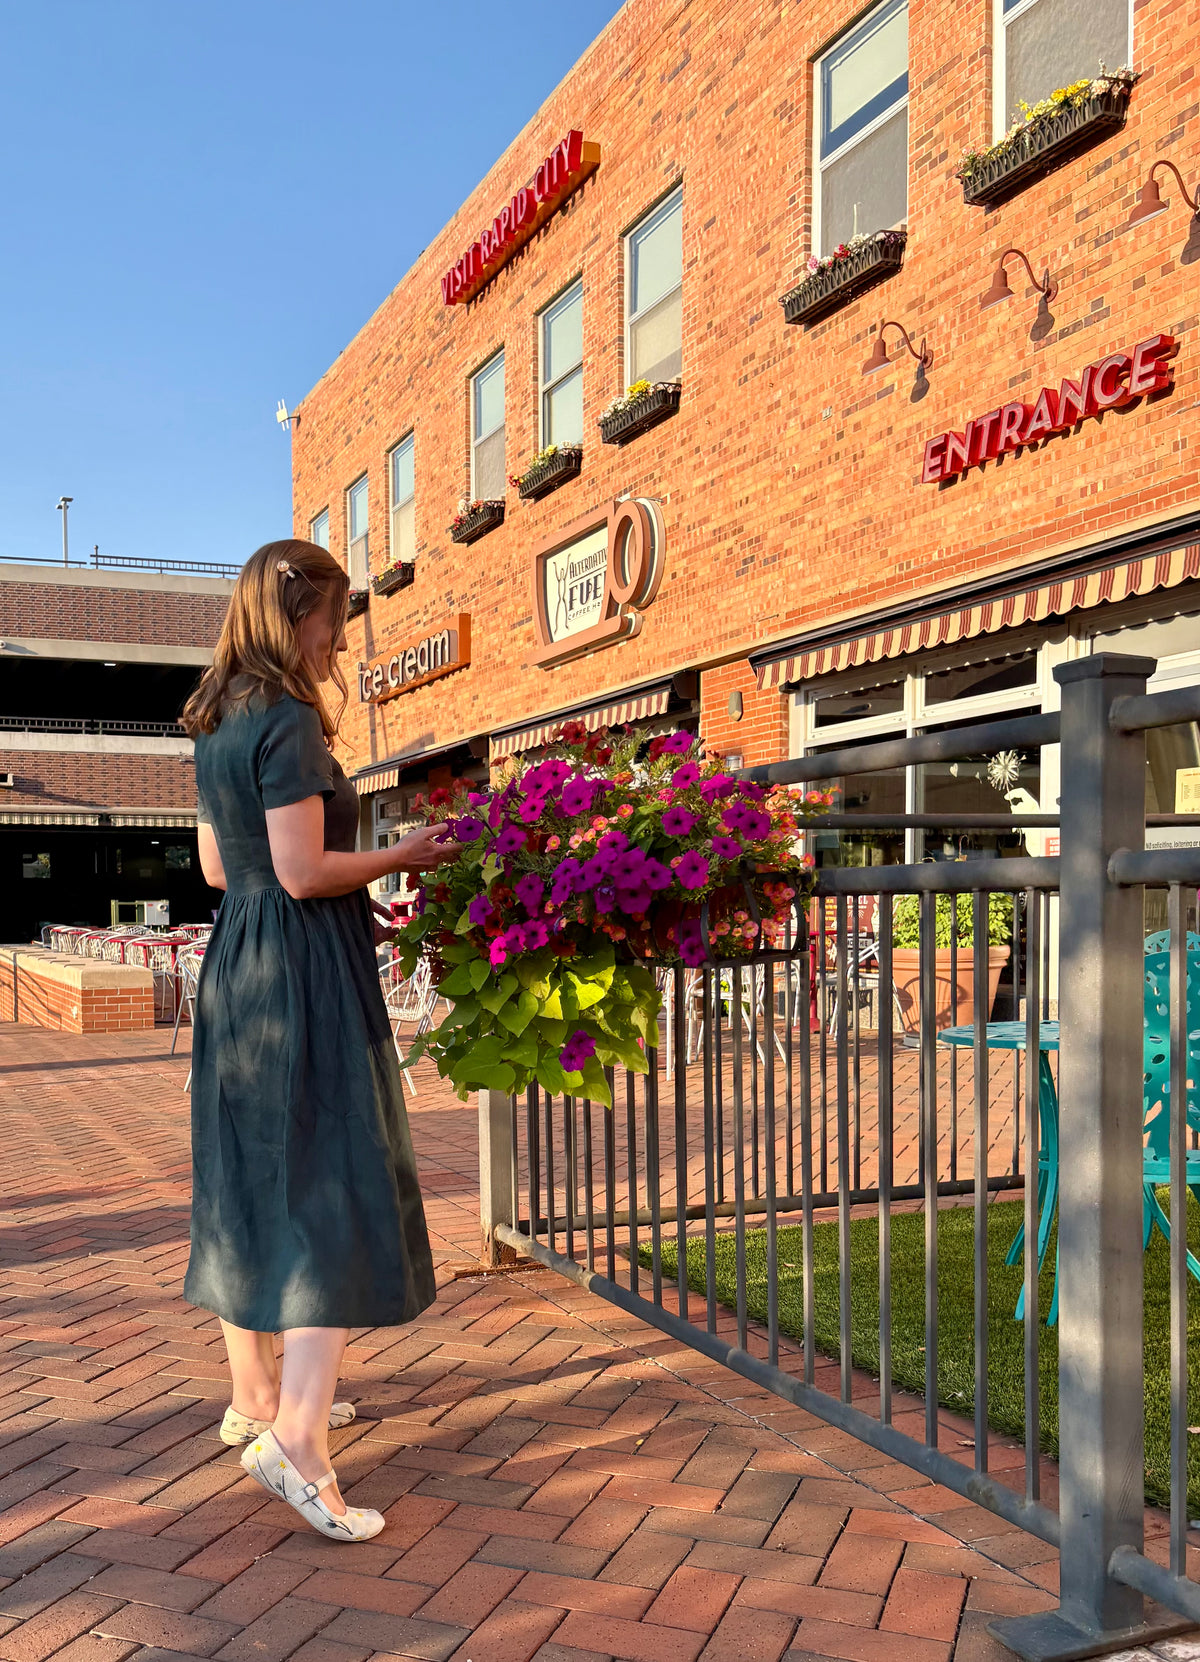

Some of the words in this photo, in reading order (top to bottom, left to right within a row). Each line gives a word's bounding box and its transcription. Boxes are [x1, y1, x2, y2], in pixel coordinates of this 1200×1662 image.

[441, 243, 480, 305] VISIT
[481, 187, 531, 264] RAPID
[534, 130, 579, 203] CITY
[922, 334, 1170, 483] ENTRANCE
[569, 547, 608, 579] ALTERNATIV
[358, 661, 384, 702] ice
[388, 629, 454, 688] cream
